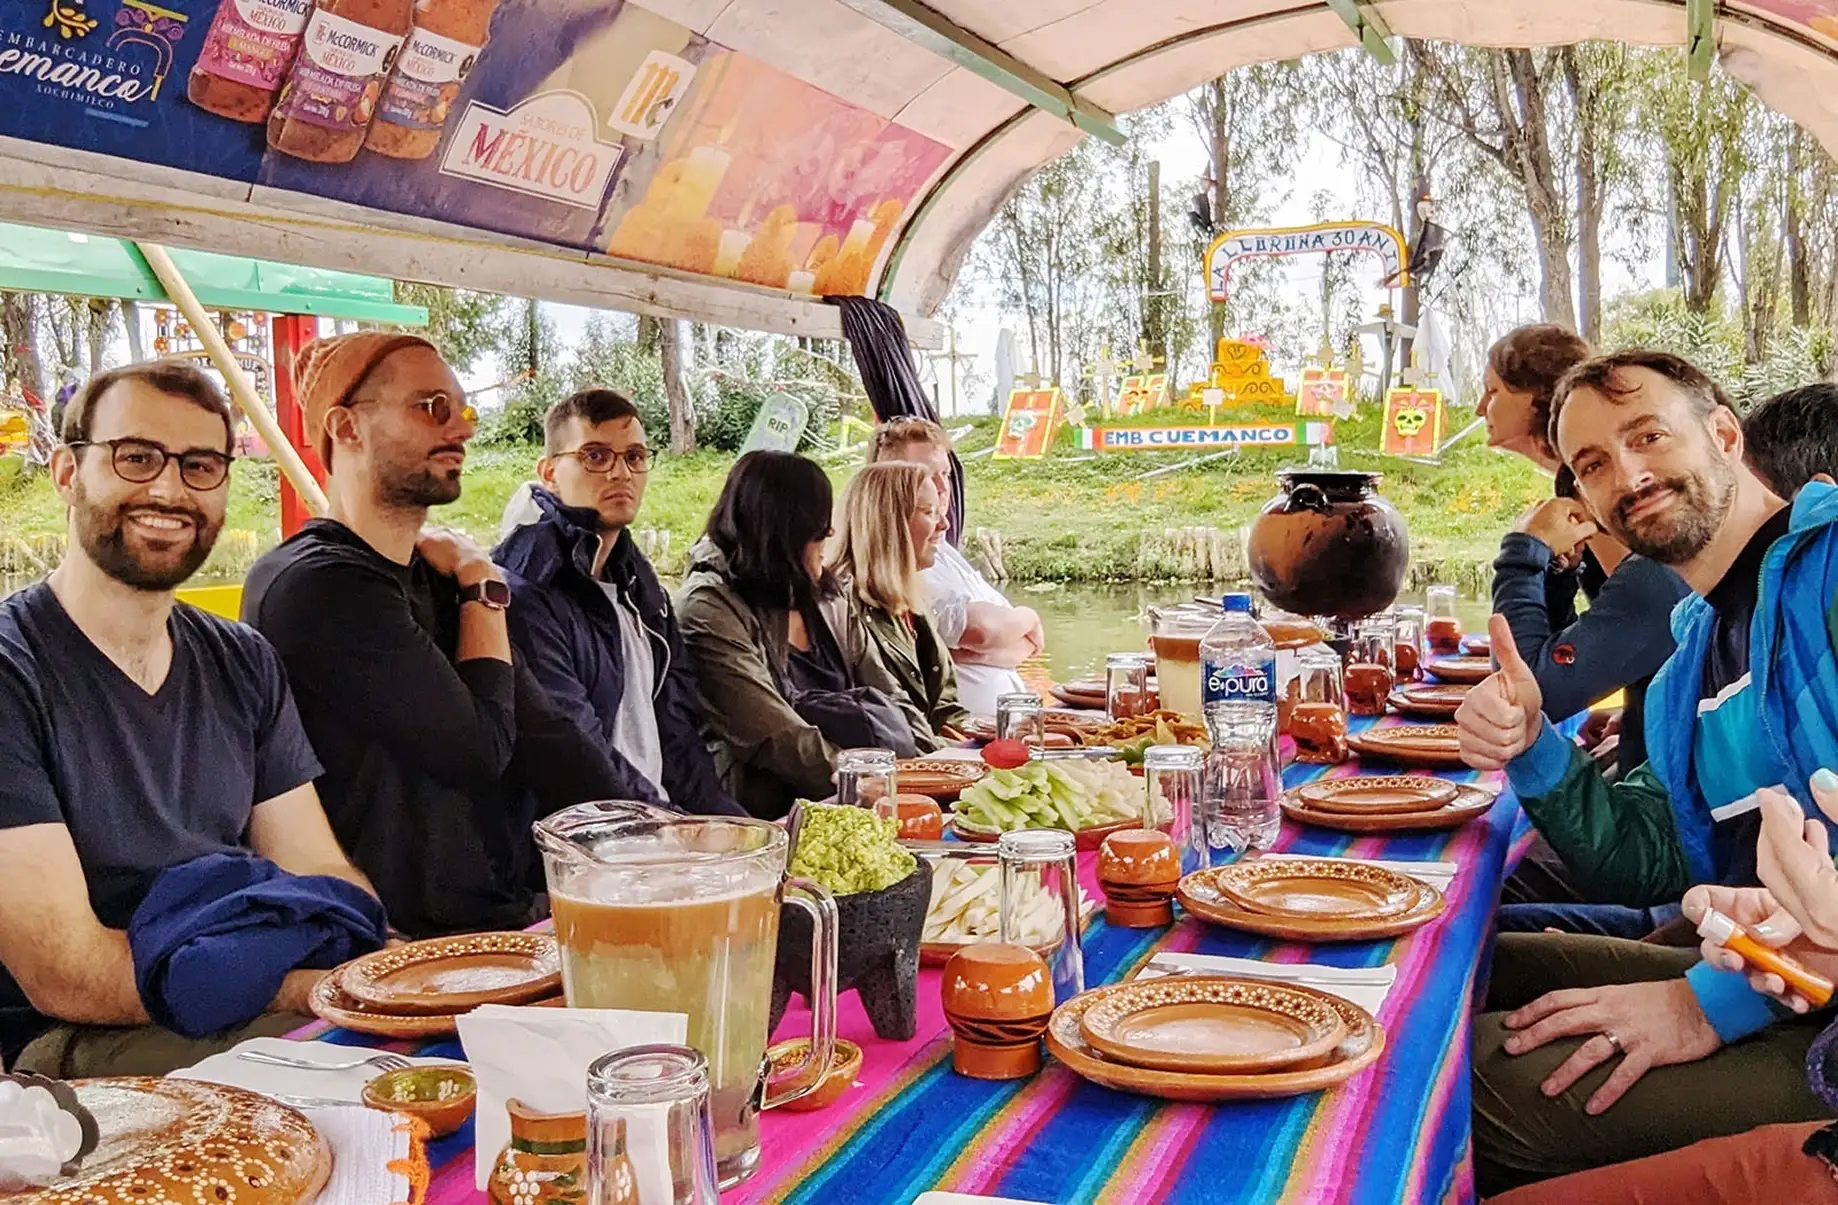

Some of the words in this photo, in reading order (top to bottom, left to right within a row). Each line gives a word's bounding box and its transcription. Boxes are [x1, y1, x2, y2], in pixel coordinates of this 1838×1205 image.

[327, 29, 378, 58] McCORMICK
[411, 40, 456, 65] McCORMICK
[35, 84, 115, 110] XOCHIMILCO
[519, 113, 567, 137] SABORES
[461, 122, 598, 194] MÉXICO
[1331, 229, 1355, 247] 30
[767, 417, 789, 433] RIP
[1104, 431, 1143, 445] EMB
[1149, 429, 1289, 443] CUEMANCO
